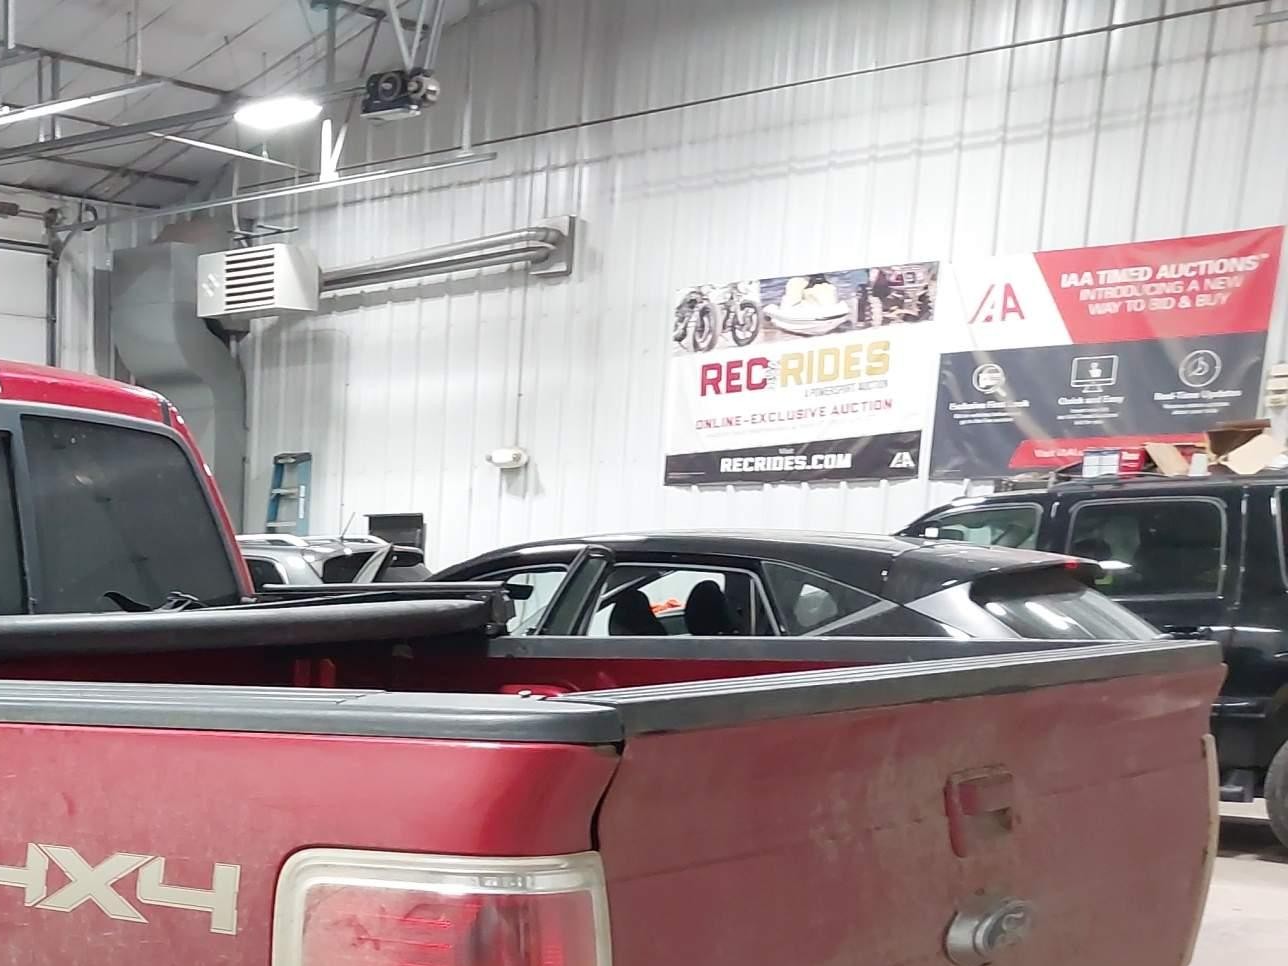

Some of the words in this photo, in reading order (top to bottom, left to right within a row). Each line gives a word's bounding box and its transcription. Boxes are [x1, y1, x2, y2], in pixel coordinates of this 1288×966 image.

[1061, 272, 1093, 288] IAA
[1096, 266, 1153, 285] TIMED
[1079, 280, 1184, 301] INTRODUCING
[1186, 279, 1200, 291] A
[1204, 274, 1246, 290] NEW
[1088, 301, 1122, 316] WAY
[1125, 298, 1146, 313] TO
[1148, 296, 1176, 311] BID
[1178, 295, 1191, 309] &
[1195, 293, 1232, 308] BUY
[700, 356, 770, 397] REC
[778, 340, 891, 388] RIDES
[695, 405, 828, 430] ONLINE-EXCLUSIVE
[831, 398, 893, 416] AUCTION
[720, 453, 852, 473] RECRIDES.COM
